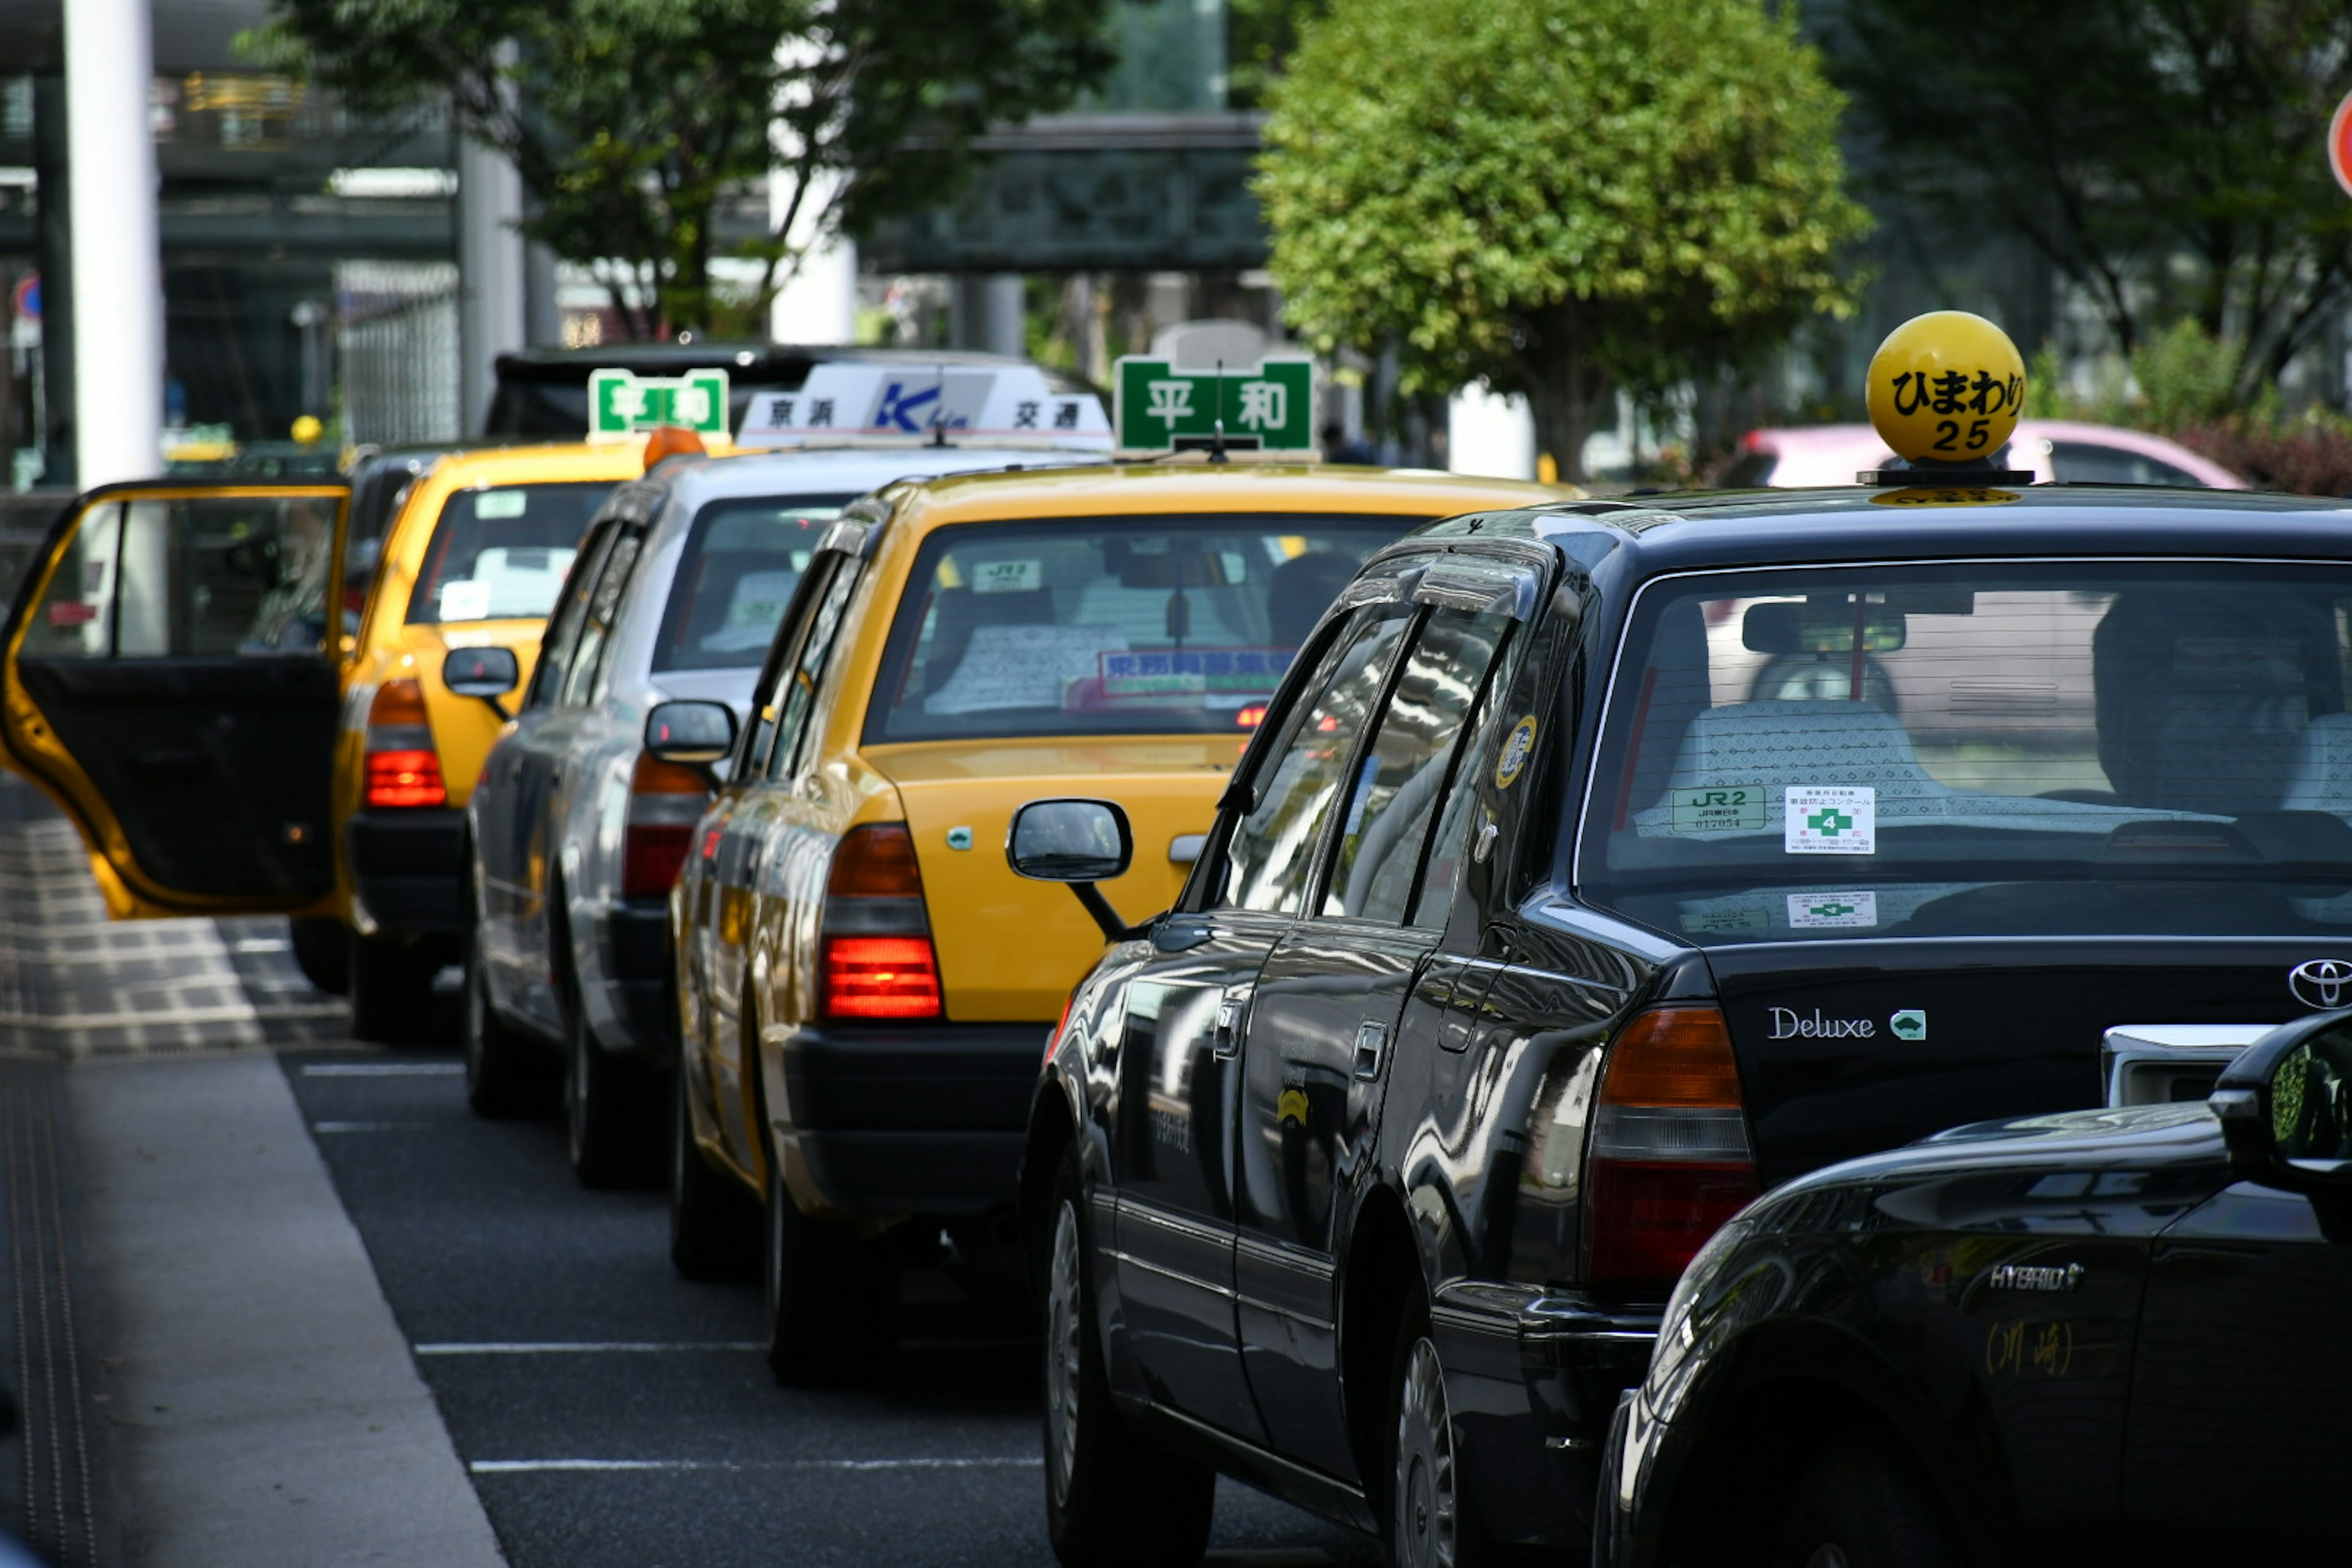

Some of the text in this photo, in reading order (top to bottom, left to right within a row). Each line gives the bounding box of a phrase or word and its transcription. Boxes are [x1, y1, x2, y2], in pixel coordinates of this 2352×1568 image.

[1145, 380, 1287, 430] 平和
[1892, 371, 2024, 417] ひまわり
[1015, 401, 1080, 429] 交通
[1933, 420, 1990, 451] 25
[1822, 815, 1836, 829] 4
[1767, 1006, 1877, 1039] Deluxe
[1989, 1265, 2065, 1291] HYBRID
